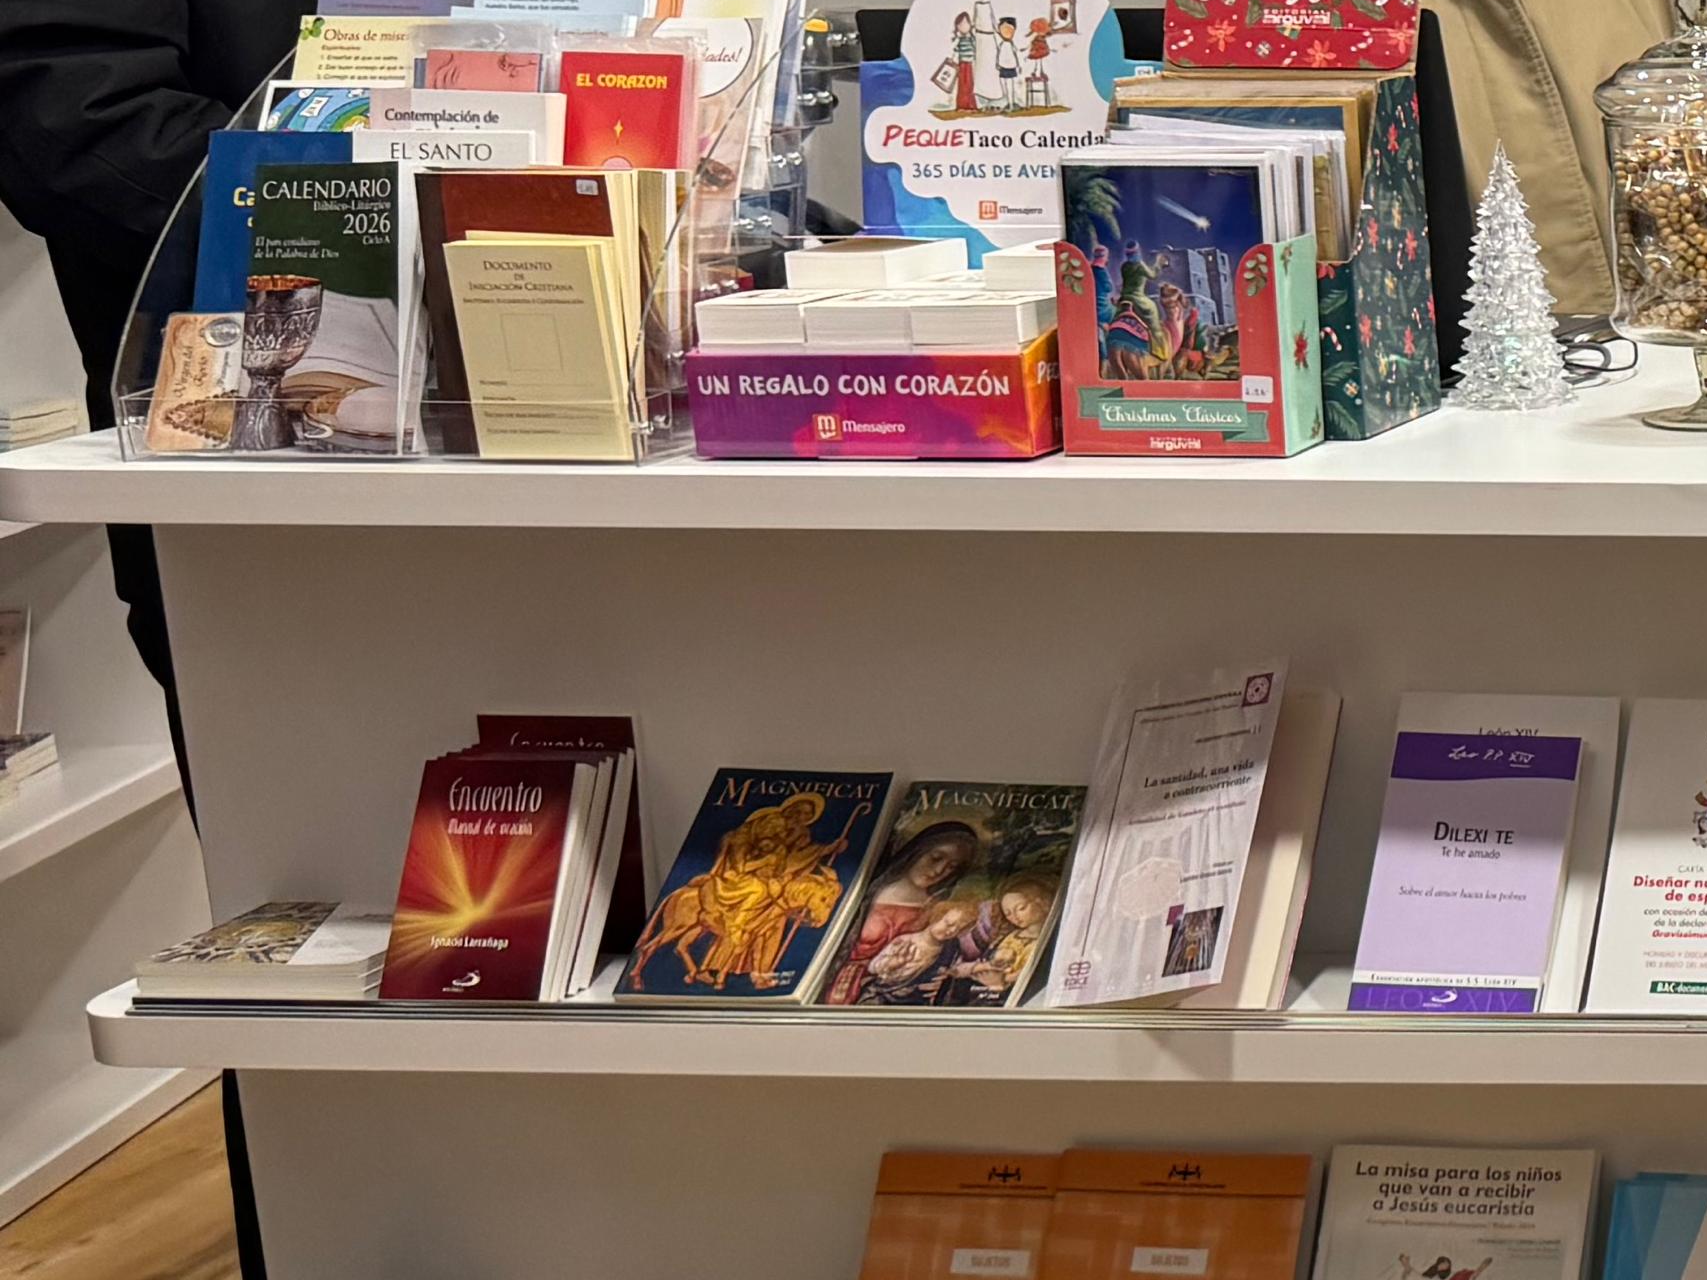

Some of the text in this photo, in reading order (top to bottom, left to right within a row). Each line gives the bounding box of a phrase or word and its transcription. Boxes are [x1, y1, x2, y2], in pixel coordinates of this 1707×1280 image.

[576, 74, 668, 89] EL CORAZON
[384, 108, 499, 126] Contemplación de
[390, 142, 492, 161] EL SANTO
[912, 163, 942, 178] 365
[950, 161, 986, 178] DÍAS
[994, 165, 1011, 178] DE
[262, 178, 391, 200] CALENDARIO
[343, 214, 391, 235] 2026
[698, 370, 1010, 397] UN REGALO CON CORAZÓN
[1102, 403, 1242, 423] Christmas Clásicos
[842, 420, 905, 434] Mensajero
[450, 777, 543, 812] Encuentro
[714, 776, 881, 807] MAGNIFICAT
[914, 788, 1076, 813] MAGNIFICAT
[1434, 821, 1514, 844] DILEXI TE
[1442, 846, 1500, 859] Te he amado
[1633, 876, 1689, 888] Diseñar
[1665, 890, 1683, 902] de
[1356, 1161, 1562, 1183] La misa para los niños
[1379, 1183, 1535, 1199] que van a recibir
[1373, 1198, 1535, 1216] a Jesús eucaristía
